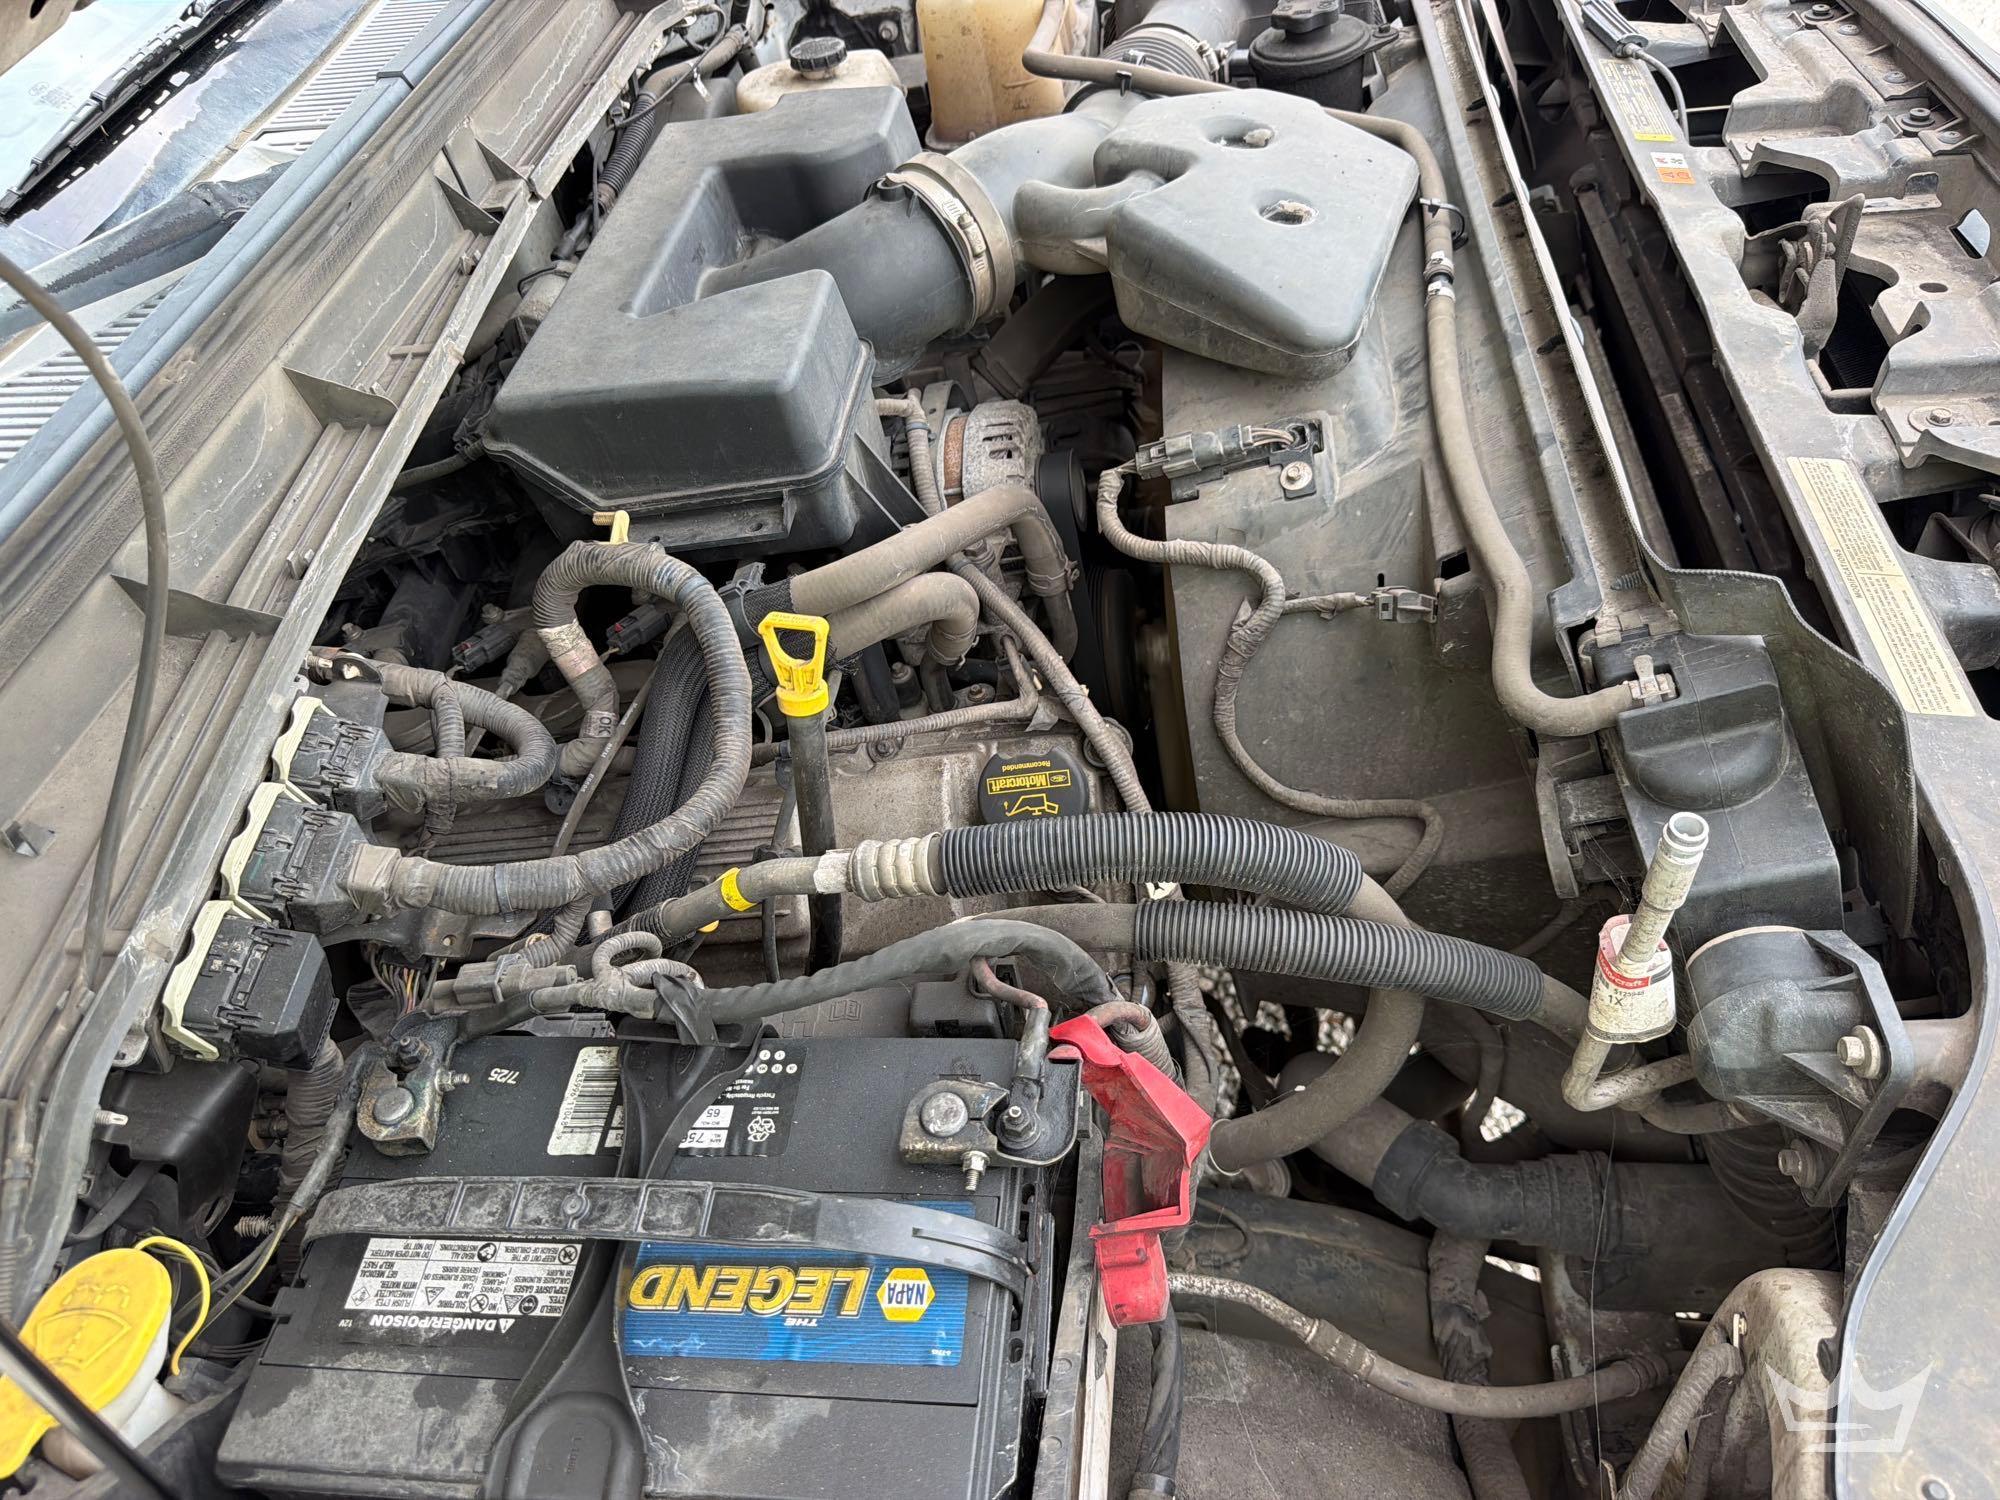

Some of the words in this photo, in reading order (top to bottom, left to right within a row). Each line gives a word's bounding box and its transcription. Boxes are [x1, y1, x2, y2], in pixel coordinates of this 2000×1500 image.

[1833, 549, 1863, 598] MODIFICATIONS
[599, 716, 612, 734] OK
[1002, 760, 1050, 772] Recommended
[990, 774, 1047, 792] Motorcraft
[488, 1068, 520, 1084] 7/25
[570, 1072, 586, 1097] 83996
[560, 1102, 574, 1126] 11048
[706, 1108, 720, 1118] 65
[395, 1250, 409, 1258] OPEN
[360, 1270, 385, 1278] MEDICAL
[402, 1281, 418, 1289] WITH
[514, 1285, 534, 1293] GASES
[535, 1286, 568, 1294] EXPLOSIVE
[628, 1264, 870, 1316] LEGEND
[887, 1283, 925, 1304] NAPA
[455, 1291, 470, 1299] ACID
[392, 1299, 411, 1307] FLUSH
[437, 1300, 466, 1309] SULFURIC
[488, 1303, 497, 1311] NO
[540, 1305, 562, 1314] SHIELD
[339, 1319, 353, 1327] 12V
[369, 1314, 497, 1331] DANGER/POISON
[784, 1317, 818, 1326] THE
